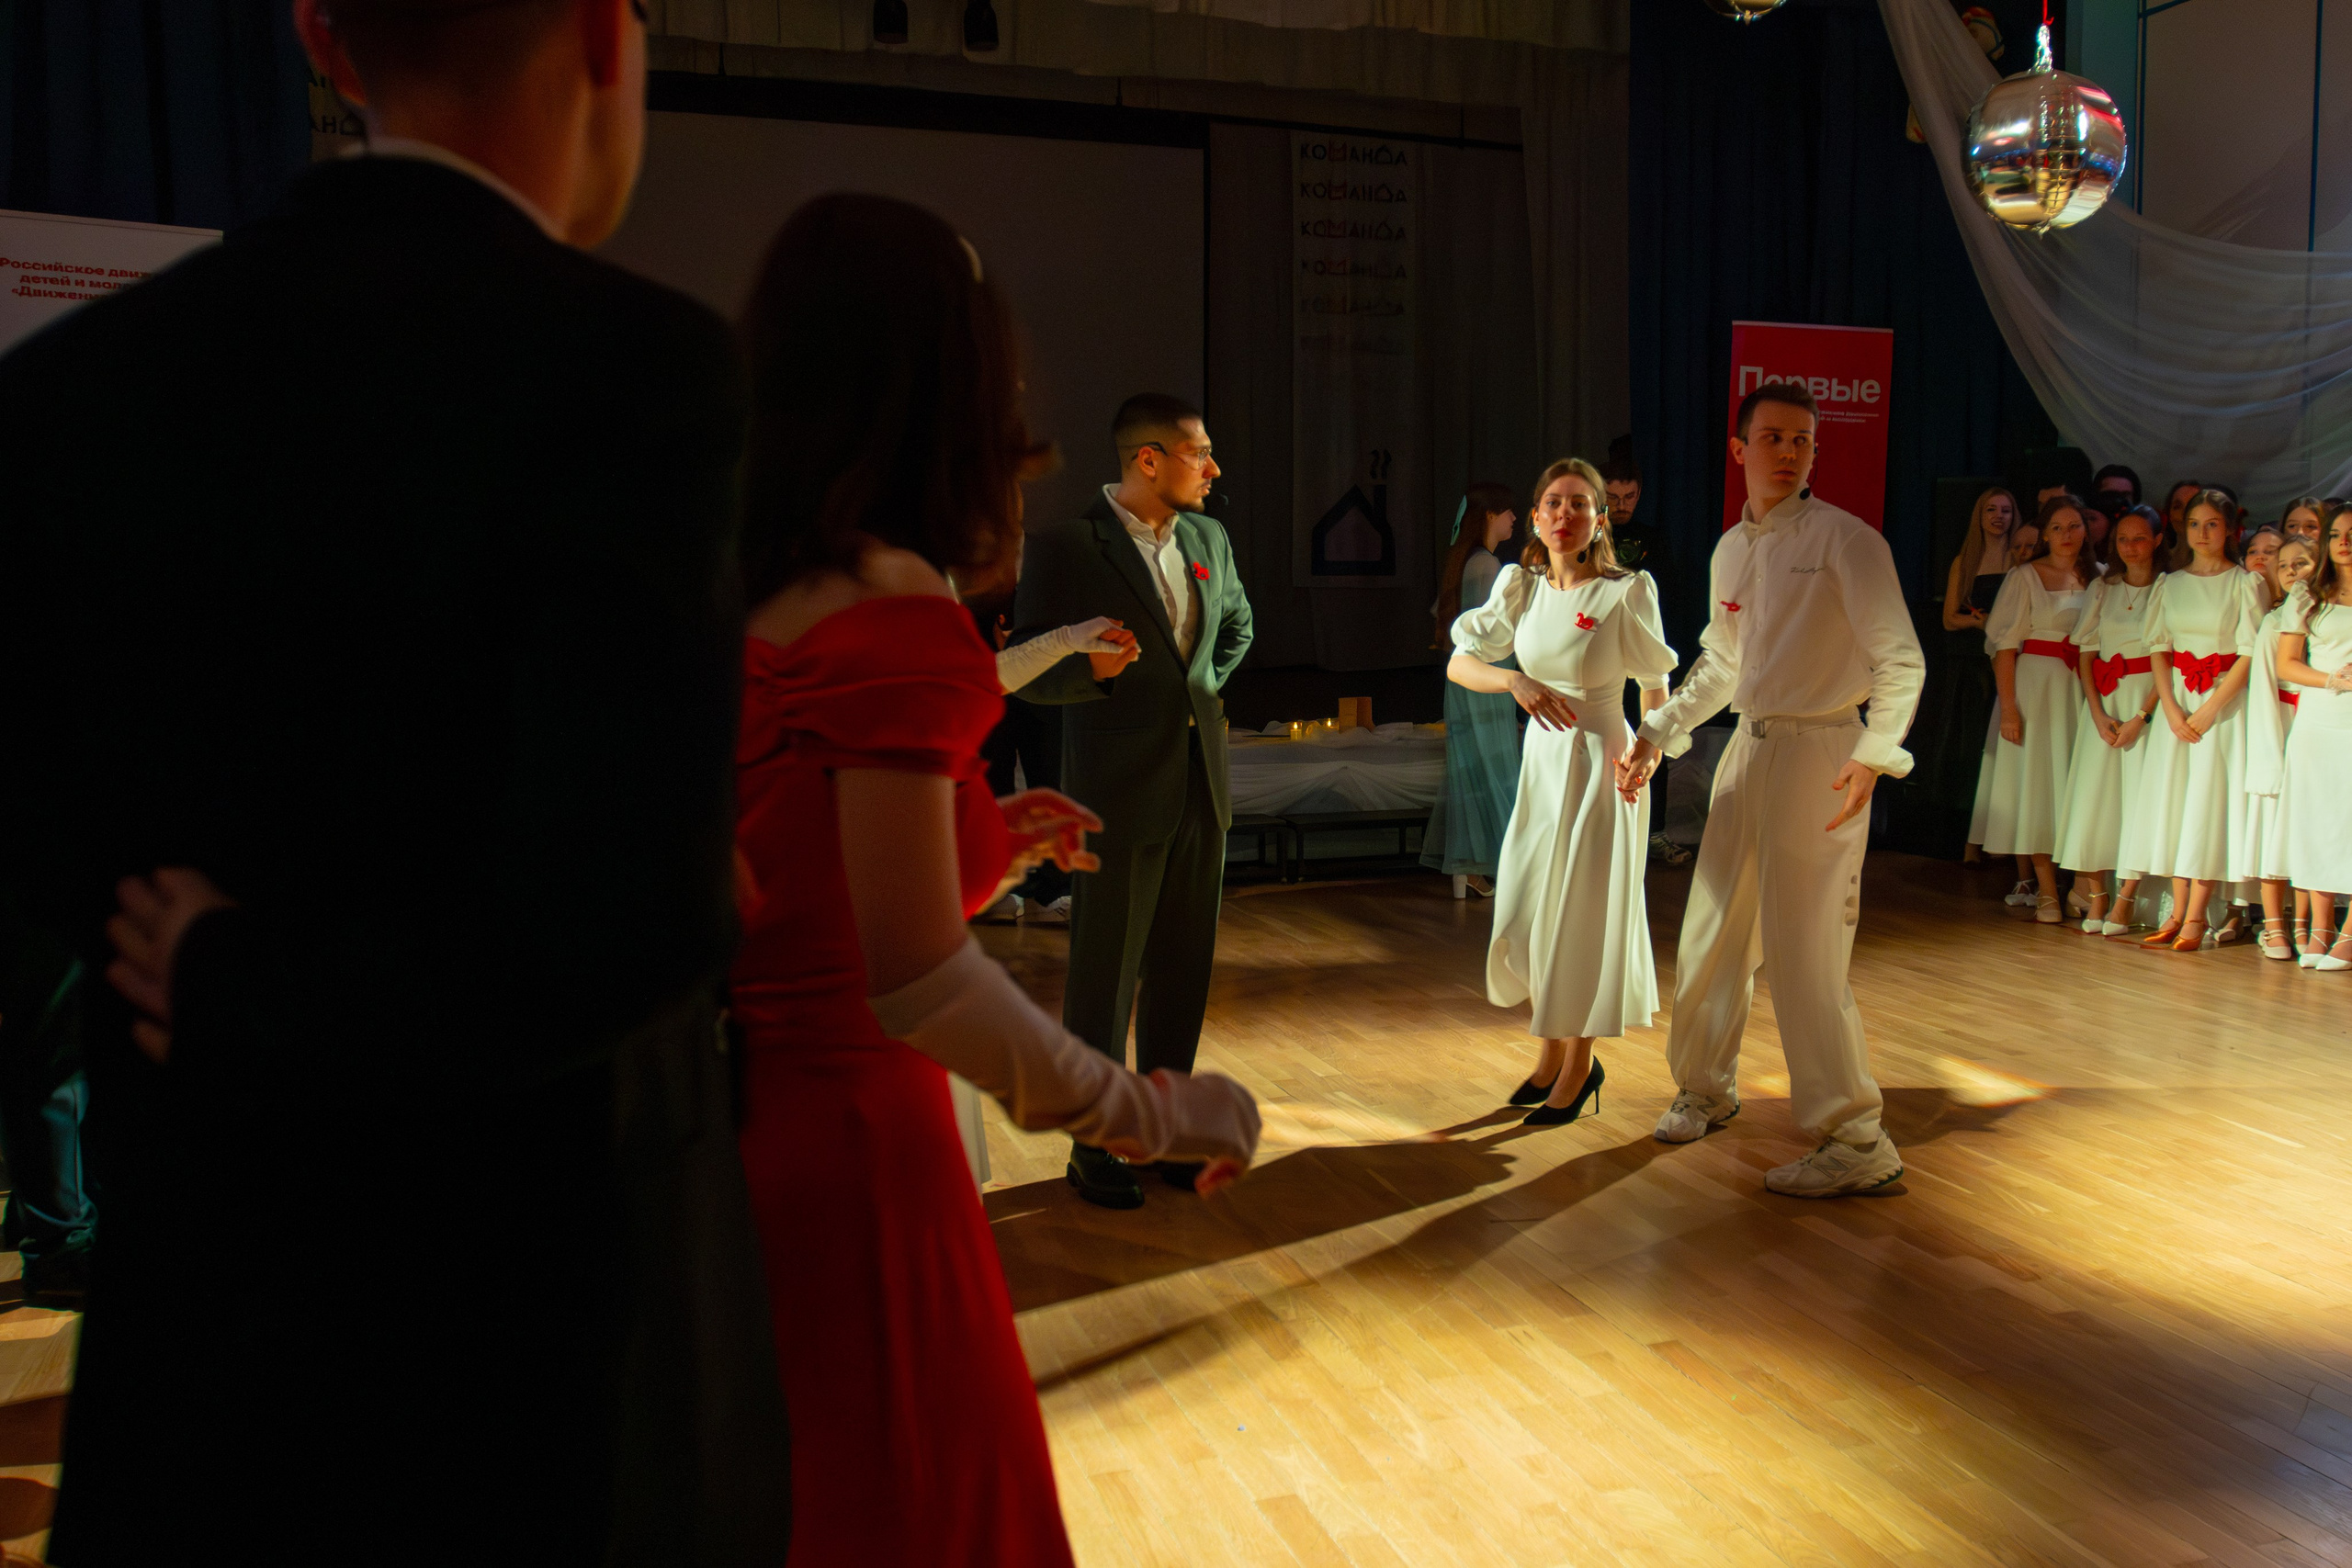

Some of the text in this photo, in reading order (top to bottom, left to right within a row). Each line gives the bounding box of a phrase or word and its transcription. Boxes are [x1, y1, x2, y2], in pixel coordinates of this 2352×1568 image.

[0, 257, 105, 276] Российское
[19, 275, 71, 287] детей
[74, 278, 85, 288] и
